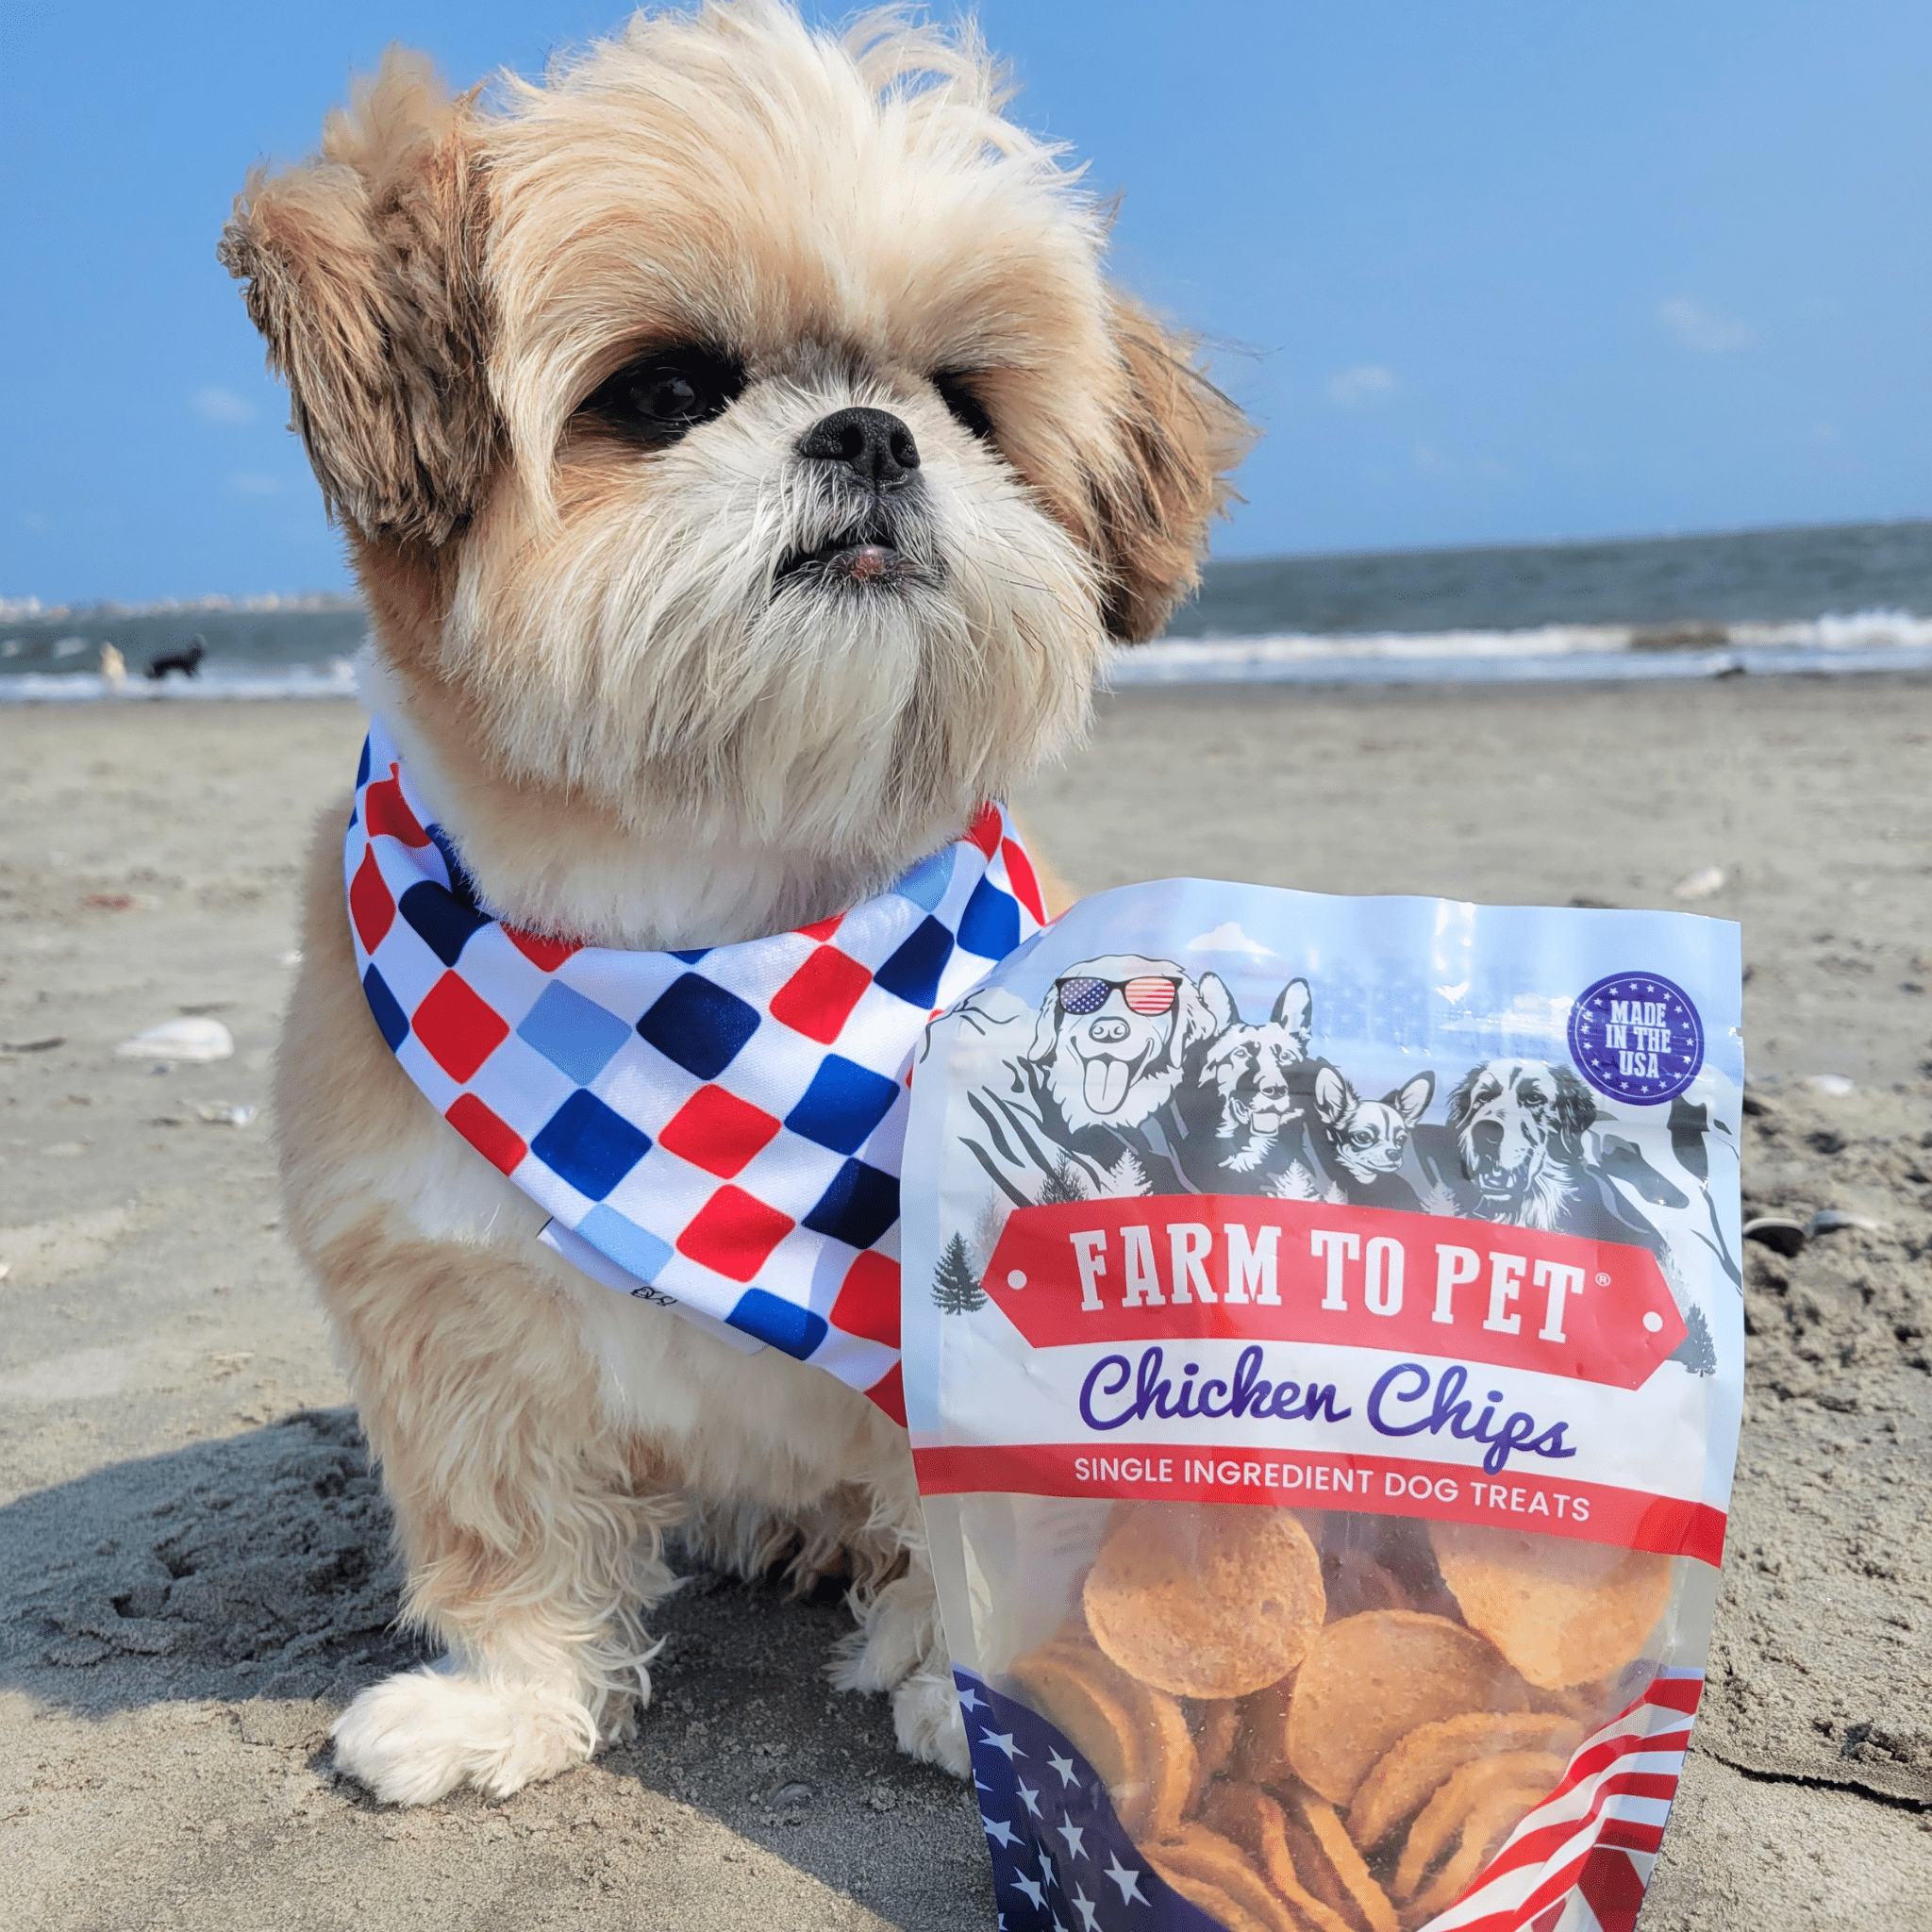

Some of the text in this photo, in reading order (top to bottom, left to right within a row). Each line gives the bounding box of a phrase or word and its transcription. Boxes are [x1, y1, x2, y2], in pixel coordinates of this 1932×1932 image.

[1609, 999, 1667, 1028] MADE
[1605, 1024, 1672, 1054] IN THE
[1619, 1050, 1660, 1079] USA
[1069, 1223, 1282, 1311] FARM
[1310, 1229, 1405, 1317] TO
[1079, 1344, 1577, 1475] Chicken Chips
[1074, 1457, 1591, 1522] SINGLE INGREDIENT DOG TREATS
